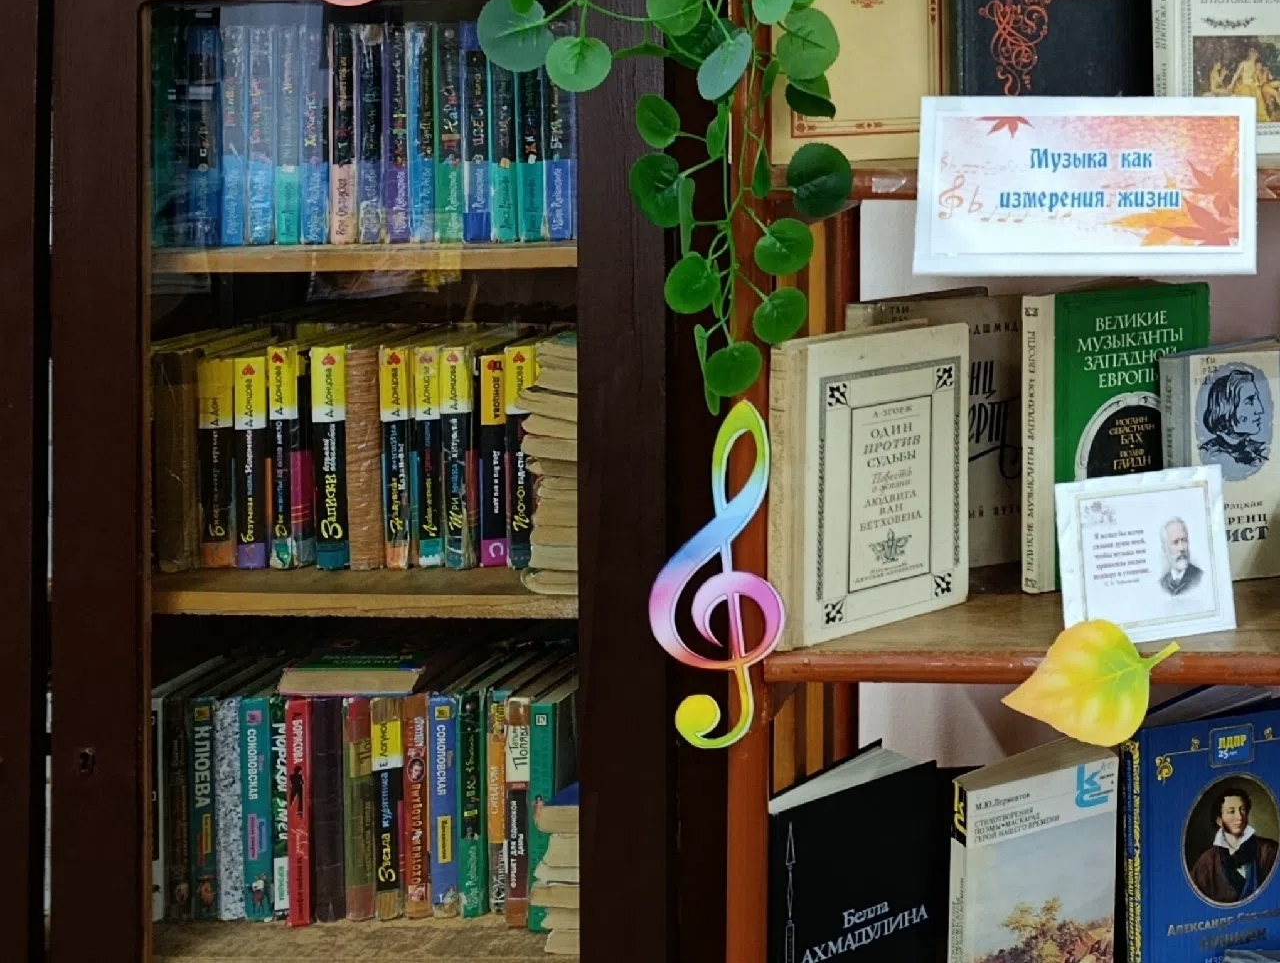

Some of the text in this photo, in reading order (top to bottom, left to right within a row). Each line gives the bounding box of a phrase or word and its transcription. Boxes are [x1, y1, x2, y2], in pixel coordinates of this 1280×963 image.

[1030, 148, 1153, 173] Музыка как
[999, 189, 1181, 212] измерения жизни
[1095, 310, 1168, 332] ВЕЛИКИЕ
[1028, 330, 1036, 374] ЕВРОПЫ
[1076, 327, 1184, 354] МУЗЫКАНТЫ
[1083, 345, 1178, 372] ЗАПАДНОЙ
[243, 378, 254, 417] Донцова
[274, 366, 284, 404] Донцова
[389, 368, 400, 406] Донцова
[450, 366, 459, 402] Донцова
[492, 376, 500, 419] ДОНЦОВА
[870, 422, 912, 439] ОДИН
[1121, 433, 1143, 445] БАХ
[321, 368, 344, 538] Записки Донцова
[863, 434, 921, 455] ПРОТИВ
[867, 449, 916, 468] СУДЬБЫ
[1113, 456, 1151, 470] ГАЙДН
[1026, 446, 1035, 518] МУЗЫКАНТЫ
[864, 489, 917, 508] ЛЮДВИГА
[880, 503, 903, 516] ВАН
[860, 510, 922, 532] БЕТХОВЕНА
[1025, 523, 1034, 572] ВЕЛИКИЕ
[293, 719, 303, 764] БОРИСОВА
[1218, 734, 1247, 749] ЛДПР
[194, 725, 211, 808] КЛЮЕВА
[247, 728, 258, 800] СОКОЛОВСКАЯ
[436, 724, 446, 795] СОКОЛОВСКАЯ
[1028, 815, 1060, 830] ВРЕМЕНИ
[510, 800, 518, 888] ФУРШЕТ ДЛЯ ОДИНОКОЙ
[516, 833, 525, 855] ДАМЫ
[843, 901, 889, 929] Белла
[802, 904, 928, 963] АХМАДУЛИНА
